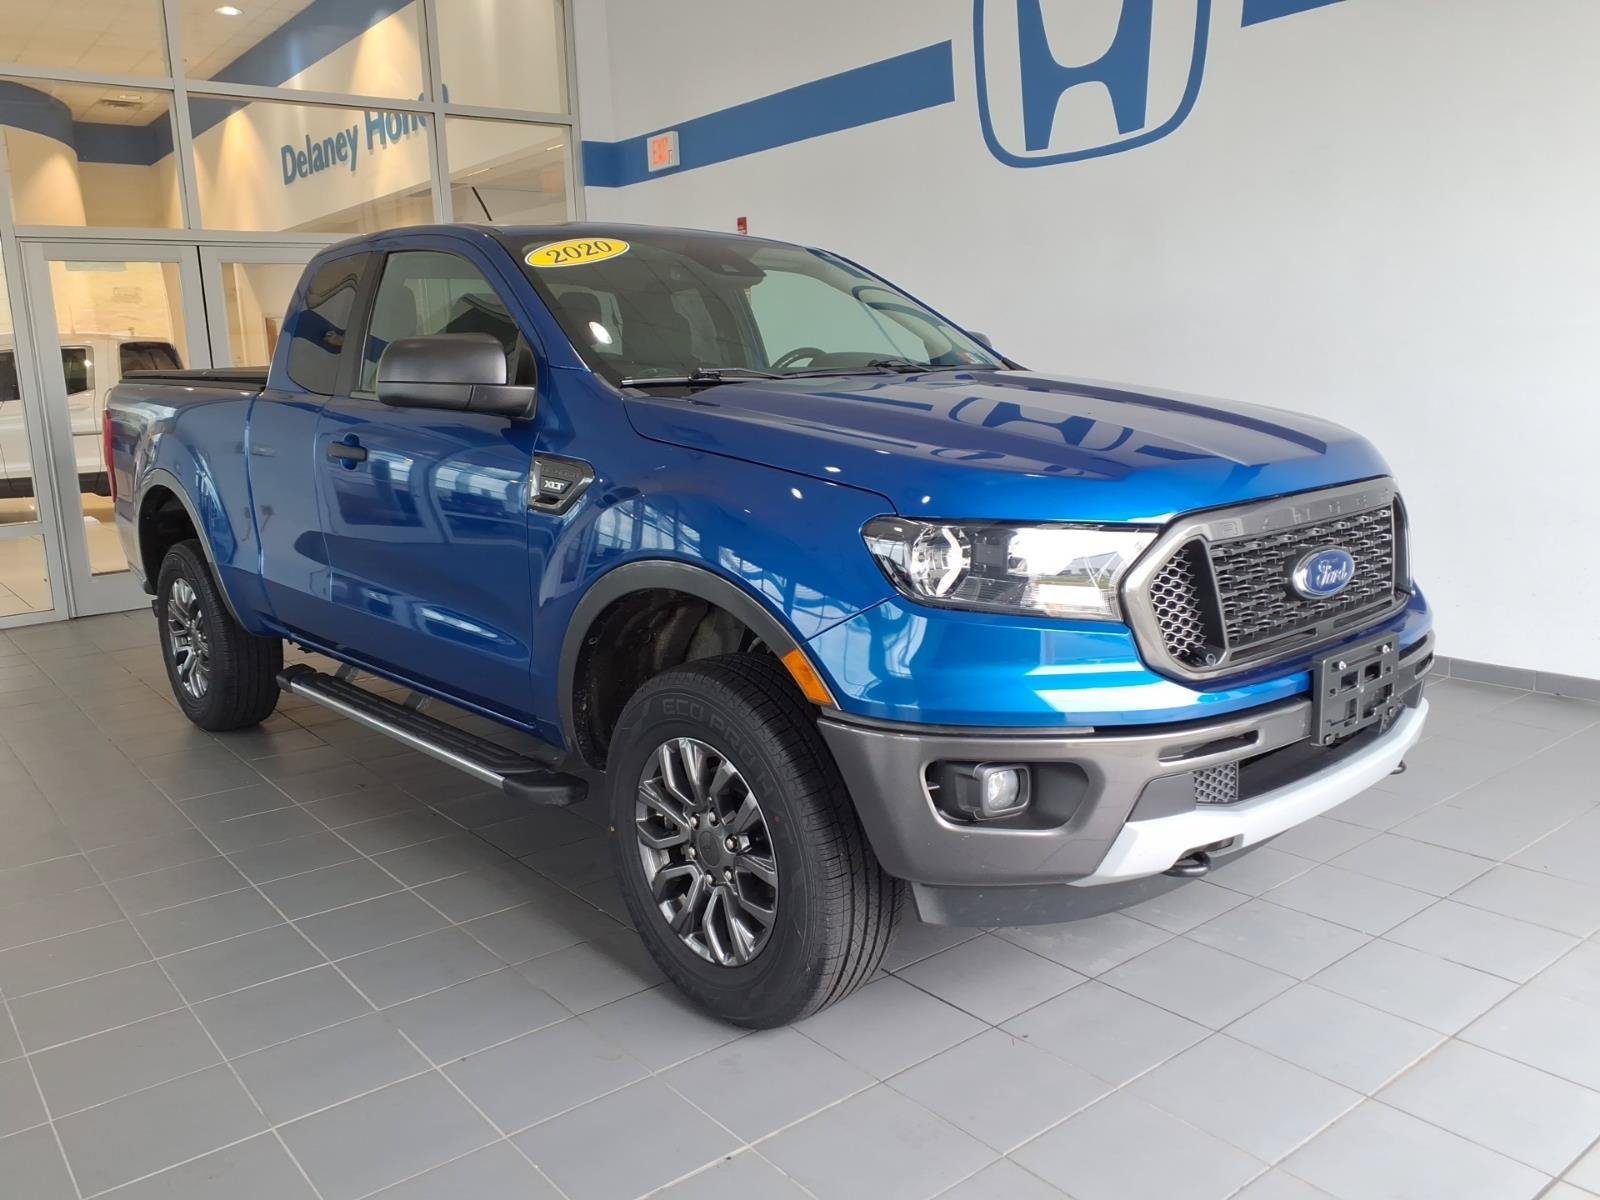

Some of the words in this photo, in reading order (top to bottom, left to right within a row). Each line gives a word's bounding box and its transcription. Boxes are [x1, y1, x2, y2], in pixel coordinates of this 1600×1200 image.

[281, 125, 358, 185] Delaney
[546, 240, 612, 263] 2020
[544, 480, 565, 490] XLT
[1317, 559, 1348, 586] Ford
[663, 699, 704, 720] ECO
